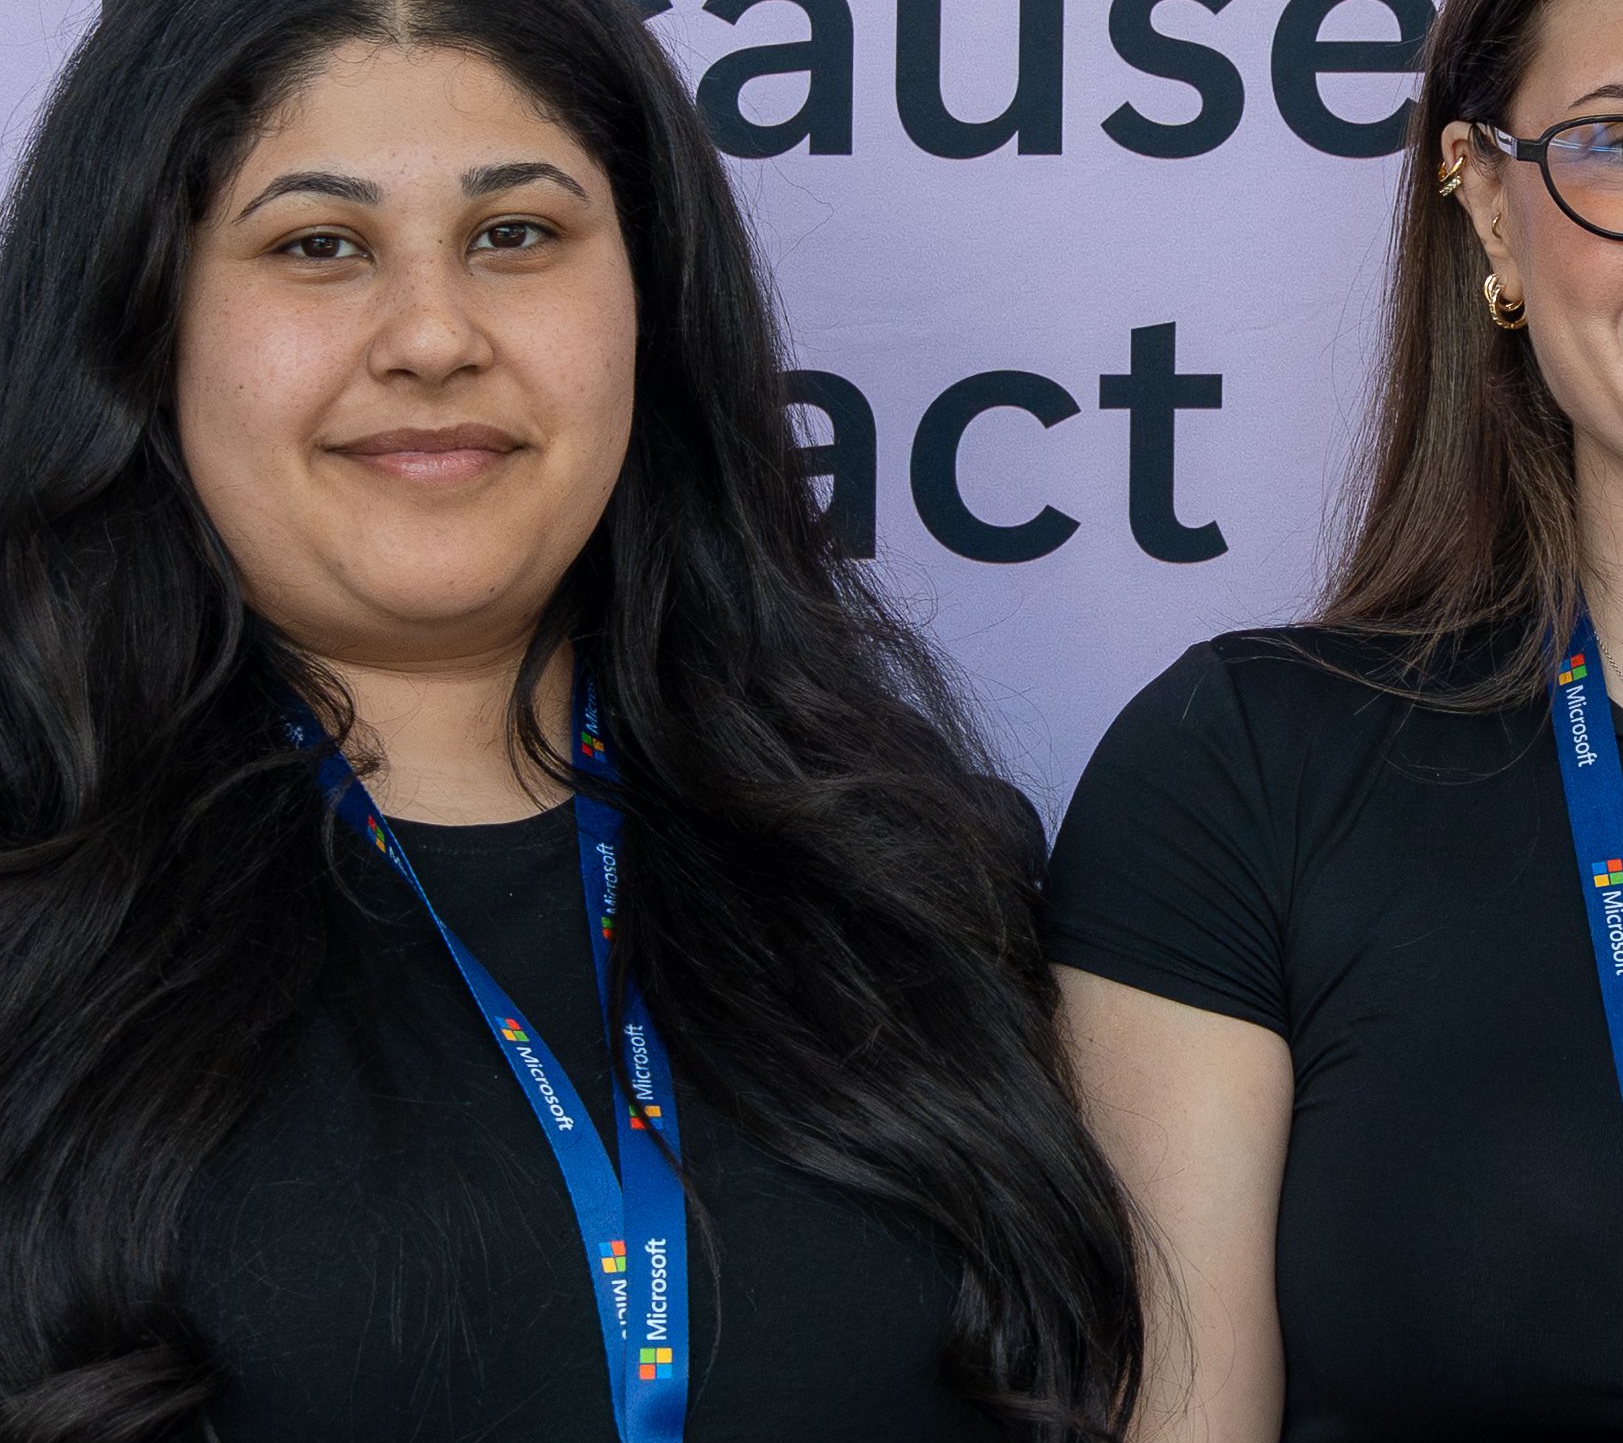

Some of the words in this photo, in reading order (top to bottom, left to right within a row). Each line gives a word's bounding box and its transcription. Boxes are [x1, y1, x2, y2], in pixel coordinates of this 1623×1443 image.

[776, 320, 1231, 565] act
[1565, 685, 1598, 768] Microsoft
[515, 1046, 574, 1132] Microsoft
[623, 1023, 655, 1101] Microsoft
[645, 1237, 668, 1341] Microsoft
